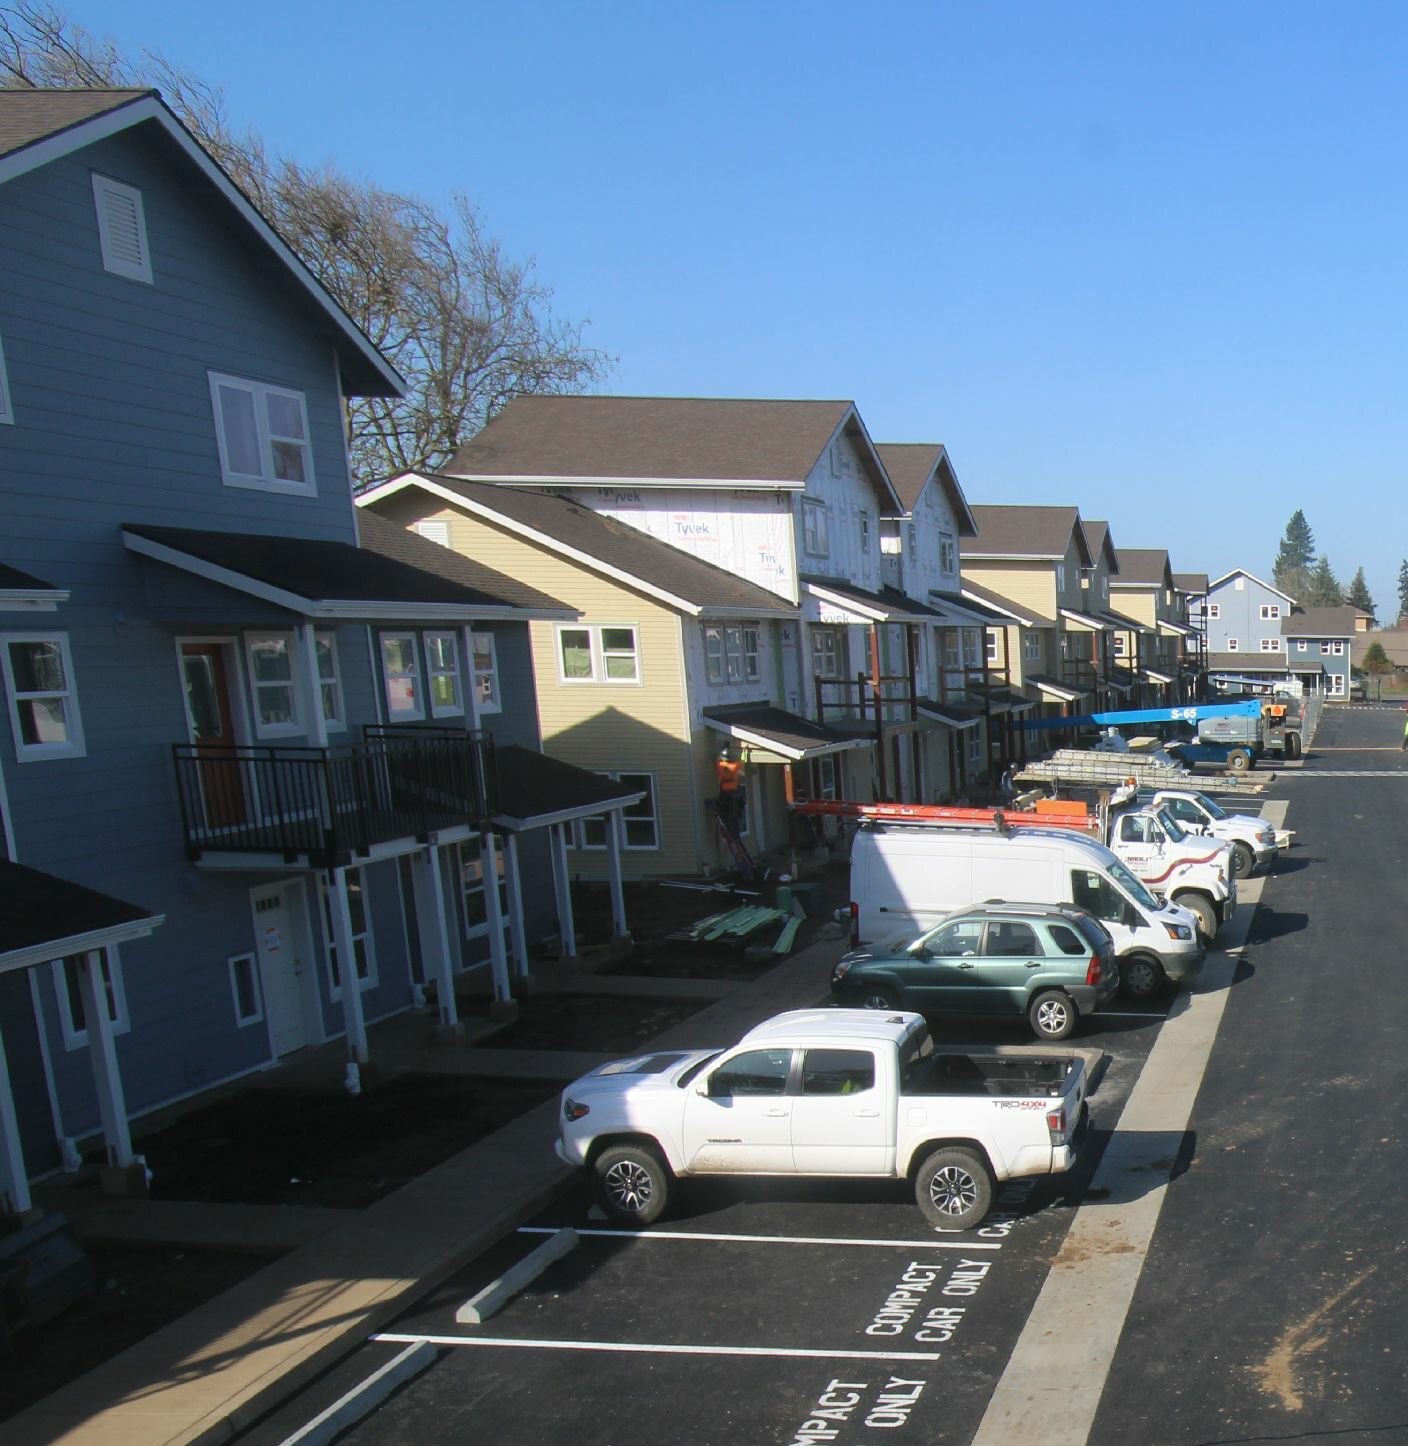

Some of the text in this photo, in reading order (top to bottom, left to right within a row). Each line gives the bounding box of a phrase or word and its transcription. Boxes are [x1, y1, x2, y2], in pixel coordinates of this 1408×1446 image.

[1171, 708, 1197, 719] S-65
[864, 1261, 943, 1336] COMPACT
[914, 1258, 993, 1342] CAR ONLY
[788, 1378, 868, 1446] MPACT
[864, 1375, 927, 1428] ONLY
